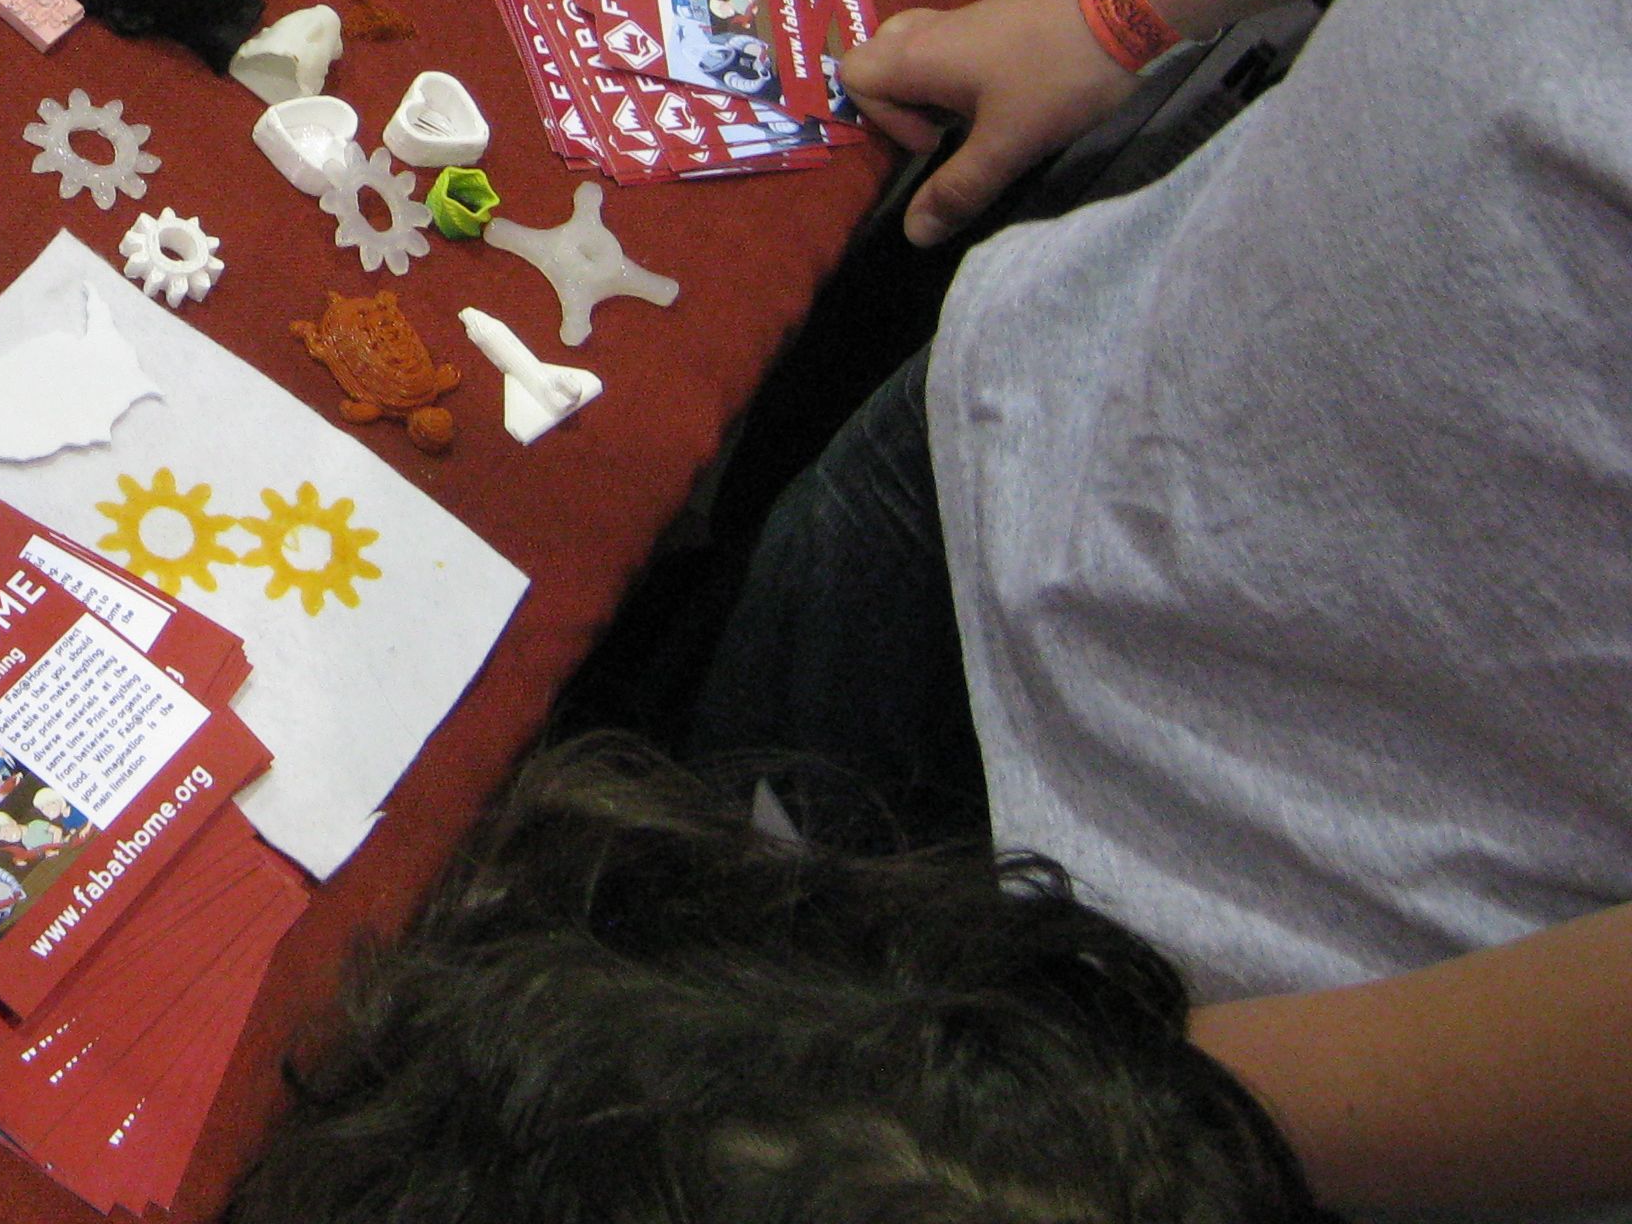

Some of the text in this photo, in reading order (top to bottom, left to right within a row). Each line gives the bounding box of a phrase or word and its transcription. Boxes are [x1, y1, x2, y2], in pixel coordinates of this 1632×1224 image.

[3, 654, 51, 704] Fab@Home
[54, 627, 82, 657] project
[7, 648, 105, 744] be able to make anything.
[20, 655, 118, 753] Our printer can use many
[30, 681, 49, 699] that
[50, 664, 67, 682] you
[68, 635, 94, 663] should
[33, 665, 129, 763] diverse materials at the
[45, 673, 142, 772] same time. Print anything
[54, 683, 152, 782] from batteries to organs to
[66, 693, 163, 793] food. With Fab@Home
[80, 781, 99, 804] your
[101, 733, 145, 779] imagination
[146, 720, 157, 730] is
[159, 702, 175, 717] the
[92, 754, 147, 813] main limitation
[29, 764, 214, 958] www.fabathome.org
